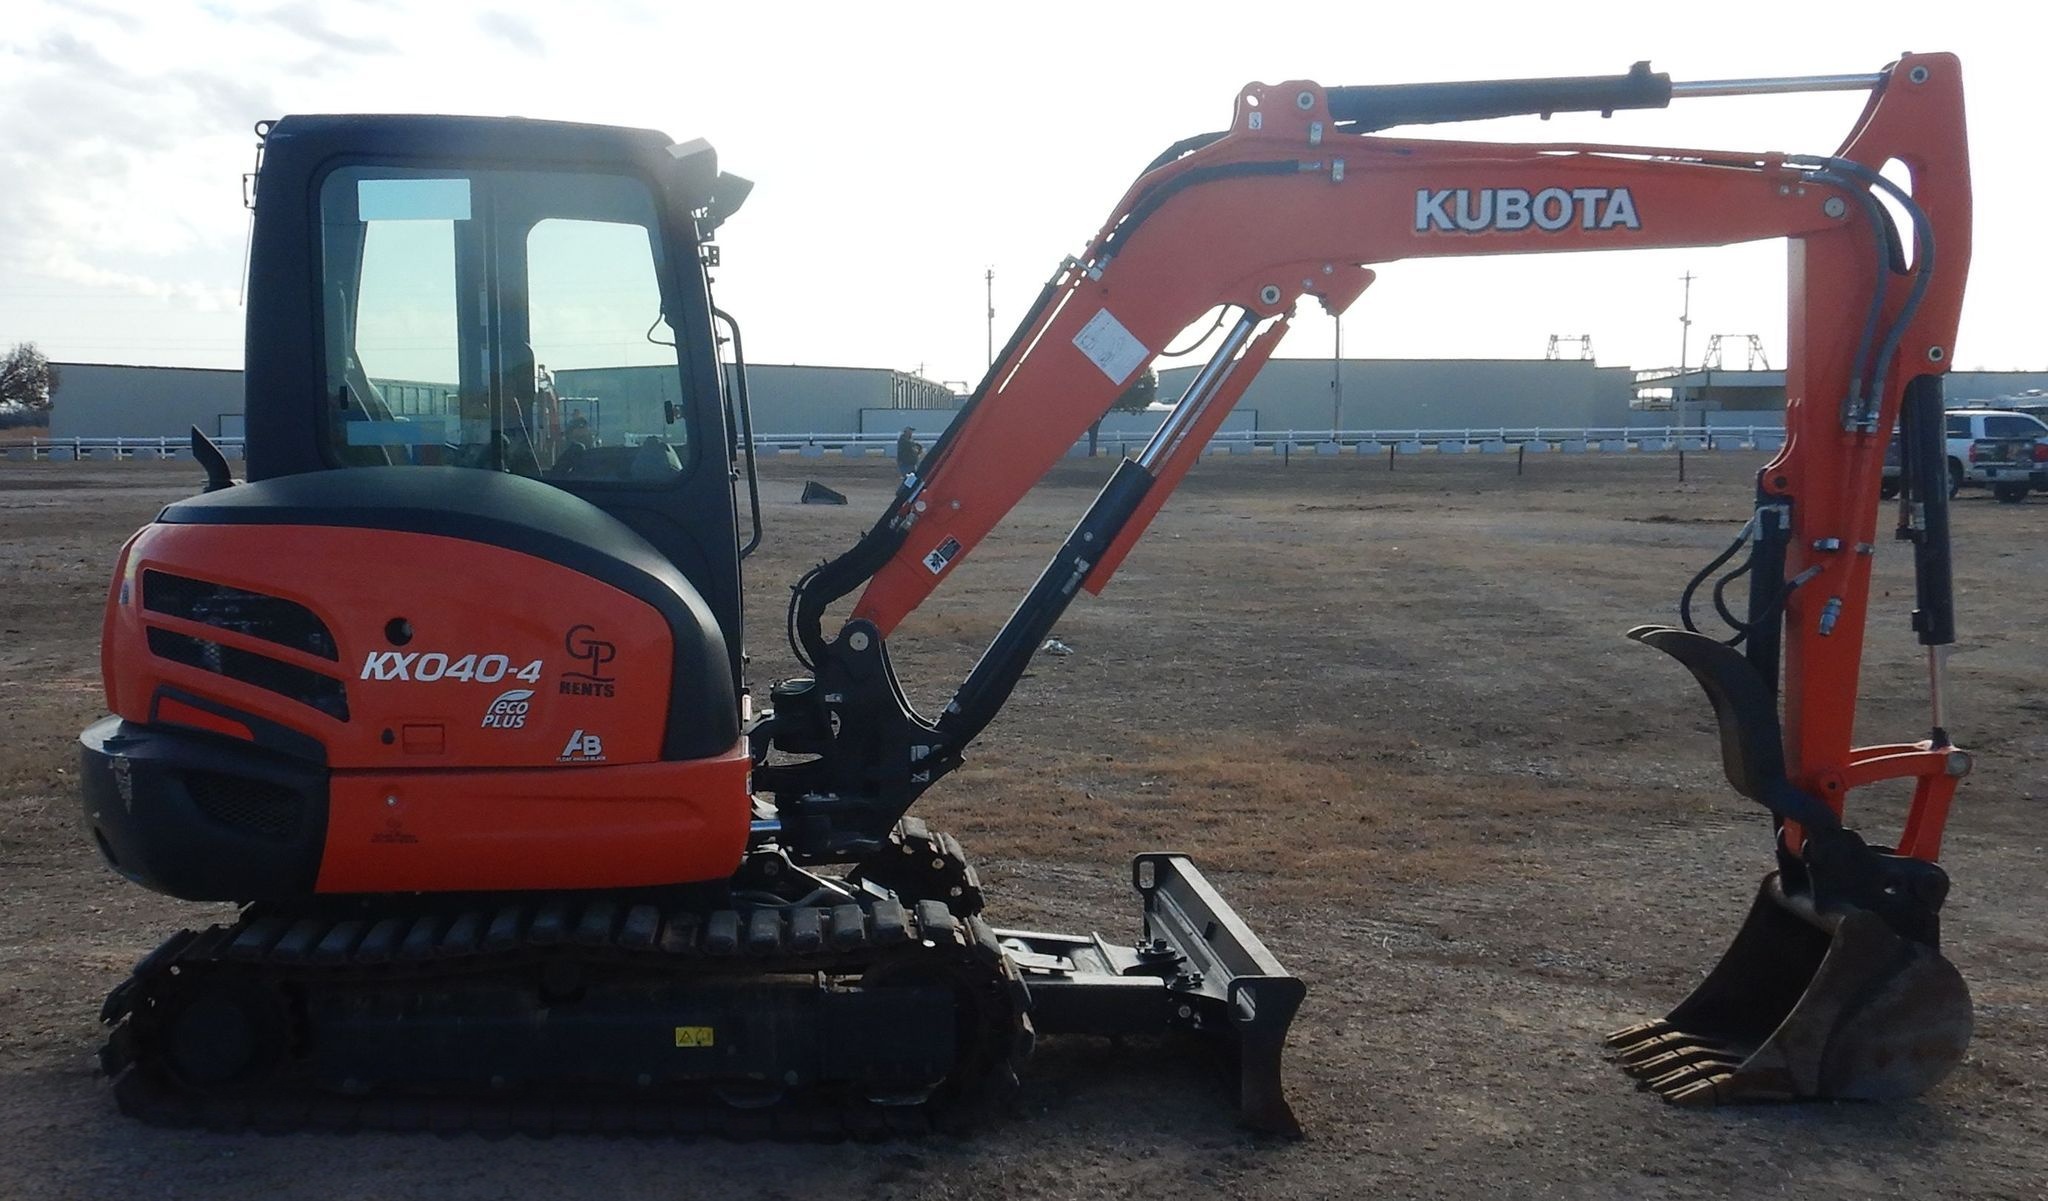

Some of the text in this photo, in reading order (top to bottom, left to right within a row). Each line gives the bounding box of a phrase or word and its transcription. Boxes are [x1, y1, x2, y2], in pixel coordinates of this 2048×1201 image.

[1415, 188, 1640, 231] KUBOTA
[360, 651, 543, 683] KX040-4
[481, 715, 526, 728] PLUS
[495, 701, 529, 714] eco
[562, 729, 602, 757] AB
